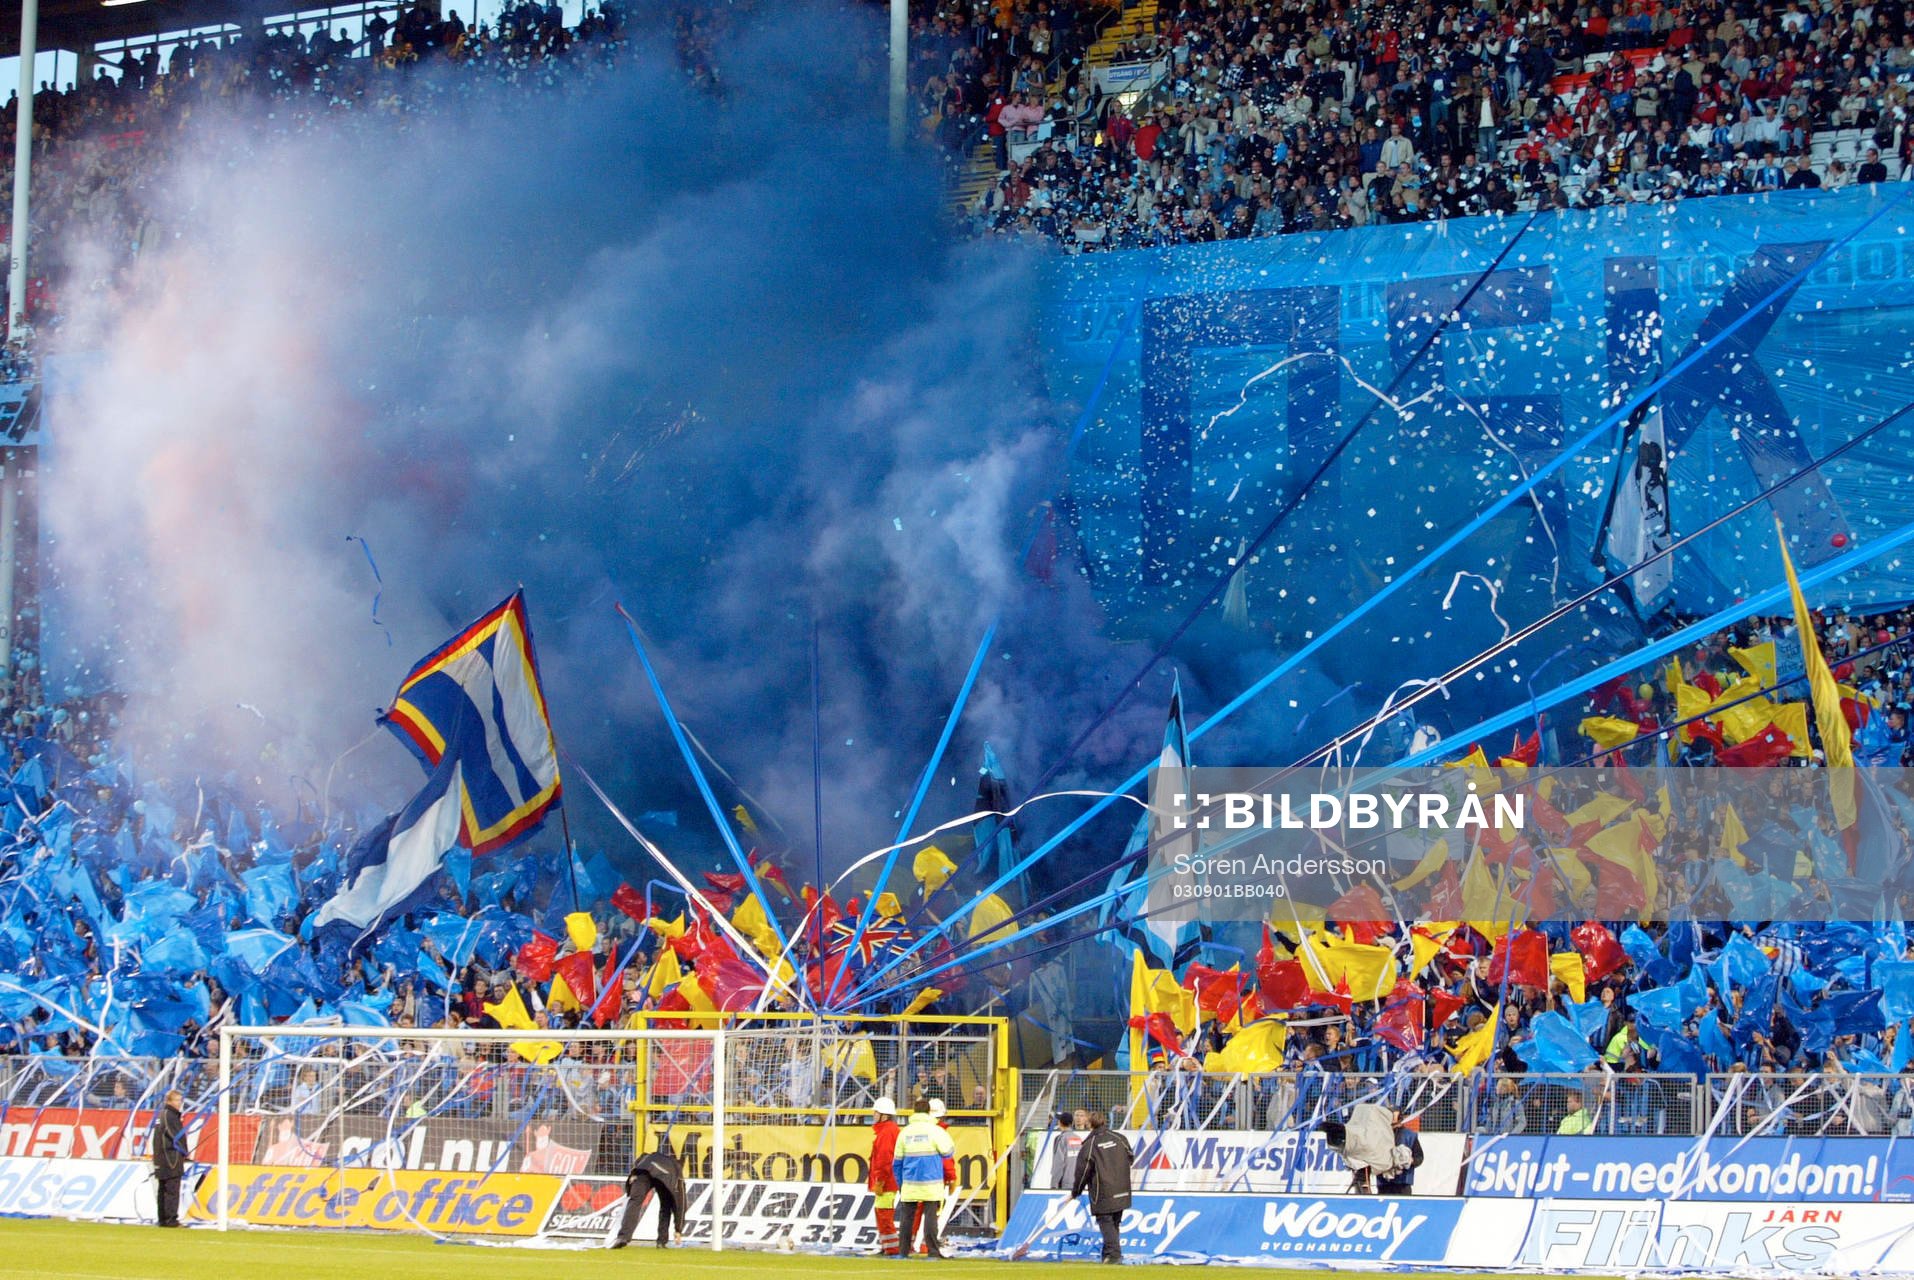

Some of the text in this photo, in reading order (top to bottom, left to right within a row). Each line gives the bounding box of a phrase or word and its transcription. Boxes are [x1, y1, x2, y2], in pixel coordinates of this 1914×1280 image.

[655, 1131, 990, 1191] Mekonon
[1695, 1152, 1878, 1195] kondom!
[207, 1173, 360, 1219] office
[373, 1178, 533, 1227] office
[1762, 1206, 1842, 1223] JÄRN
[1260, 1241, 1373, 1253] BYGGHANDEL
[1263, 1201, 1428, 1260] Woody
